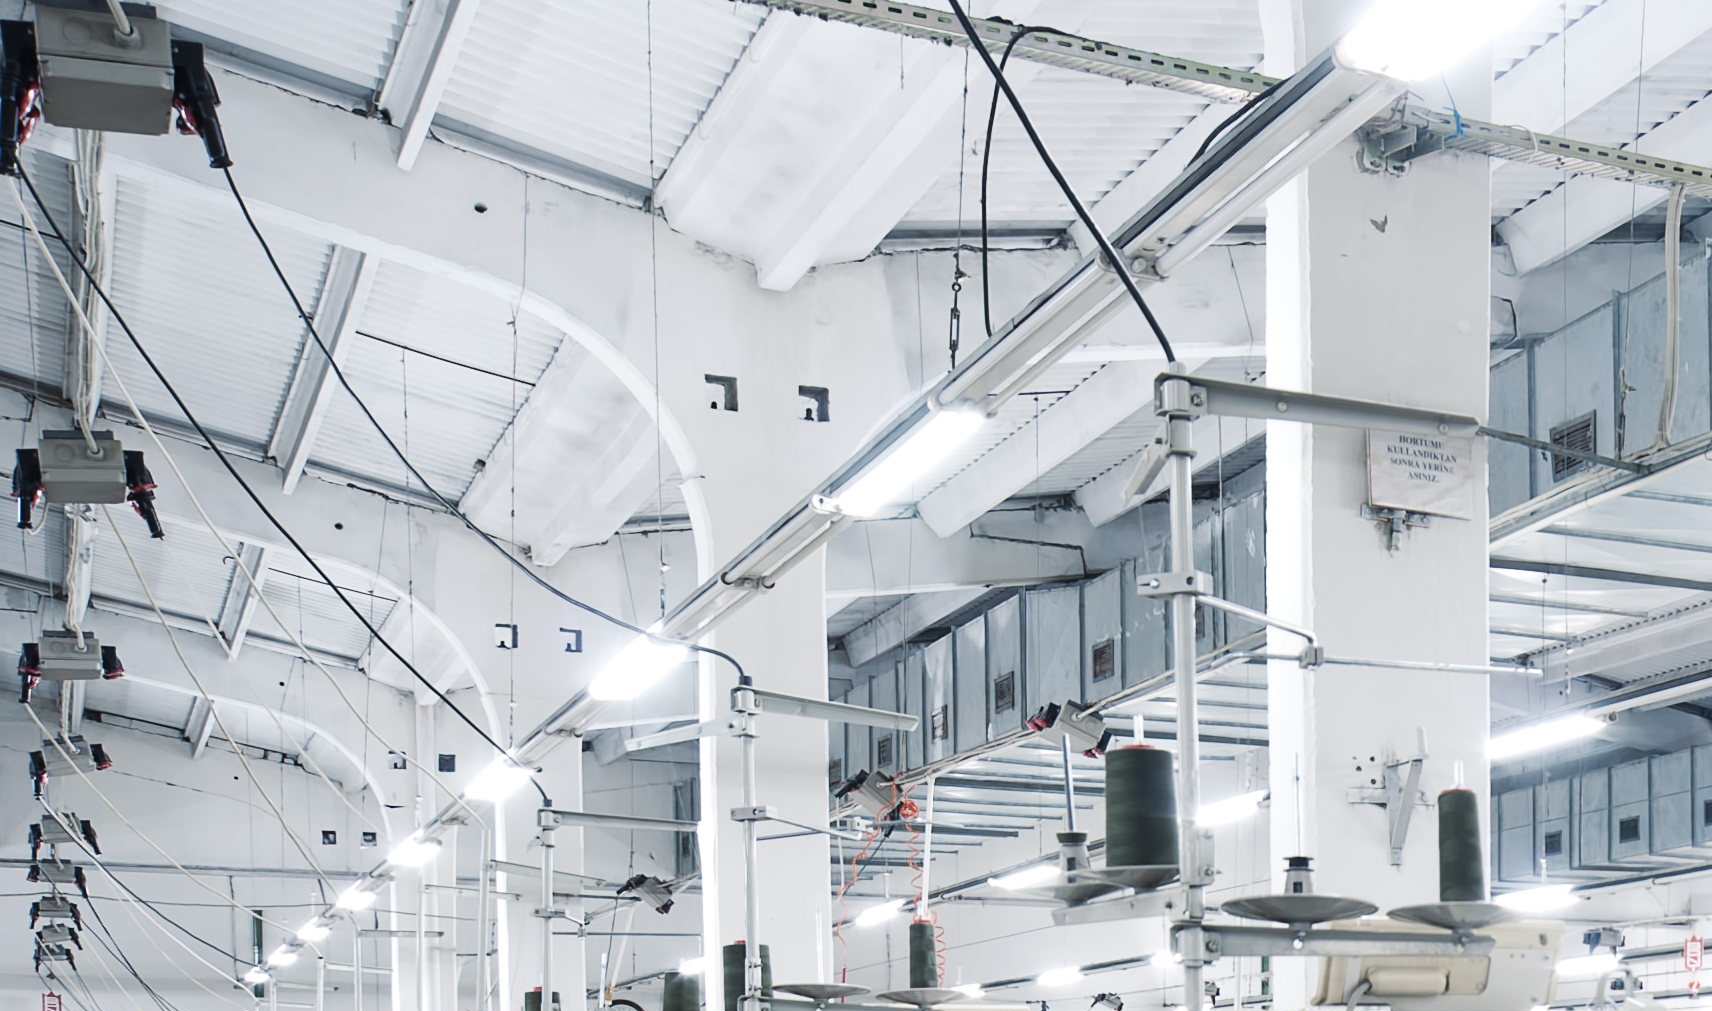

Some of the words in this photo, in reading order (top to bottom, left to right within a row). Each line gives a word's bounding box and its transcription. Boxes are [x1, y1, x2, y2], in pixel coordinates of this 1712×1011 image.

[1399, 434, 1445, 450] HORTUMU
[1387, 445, 1457, 463] KULLANDIKTAN
[1390, 457, 1420, 469] SONRA
